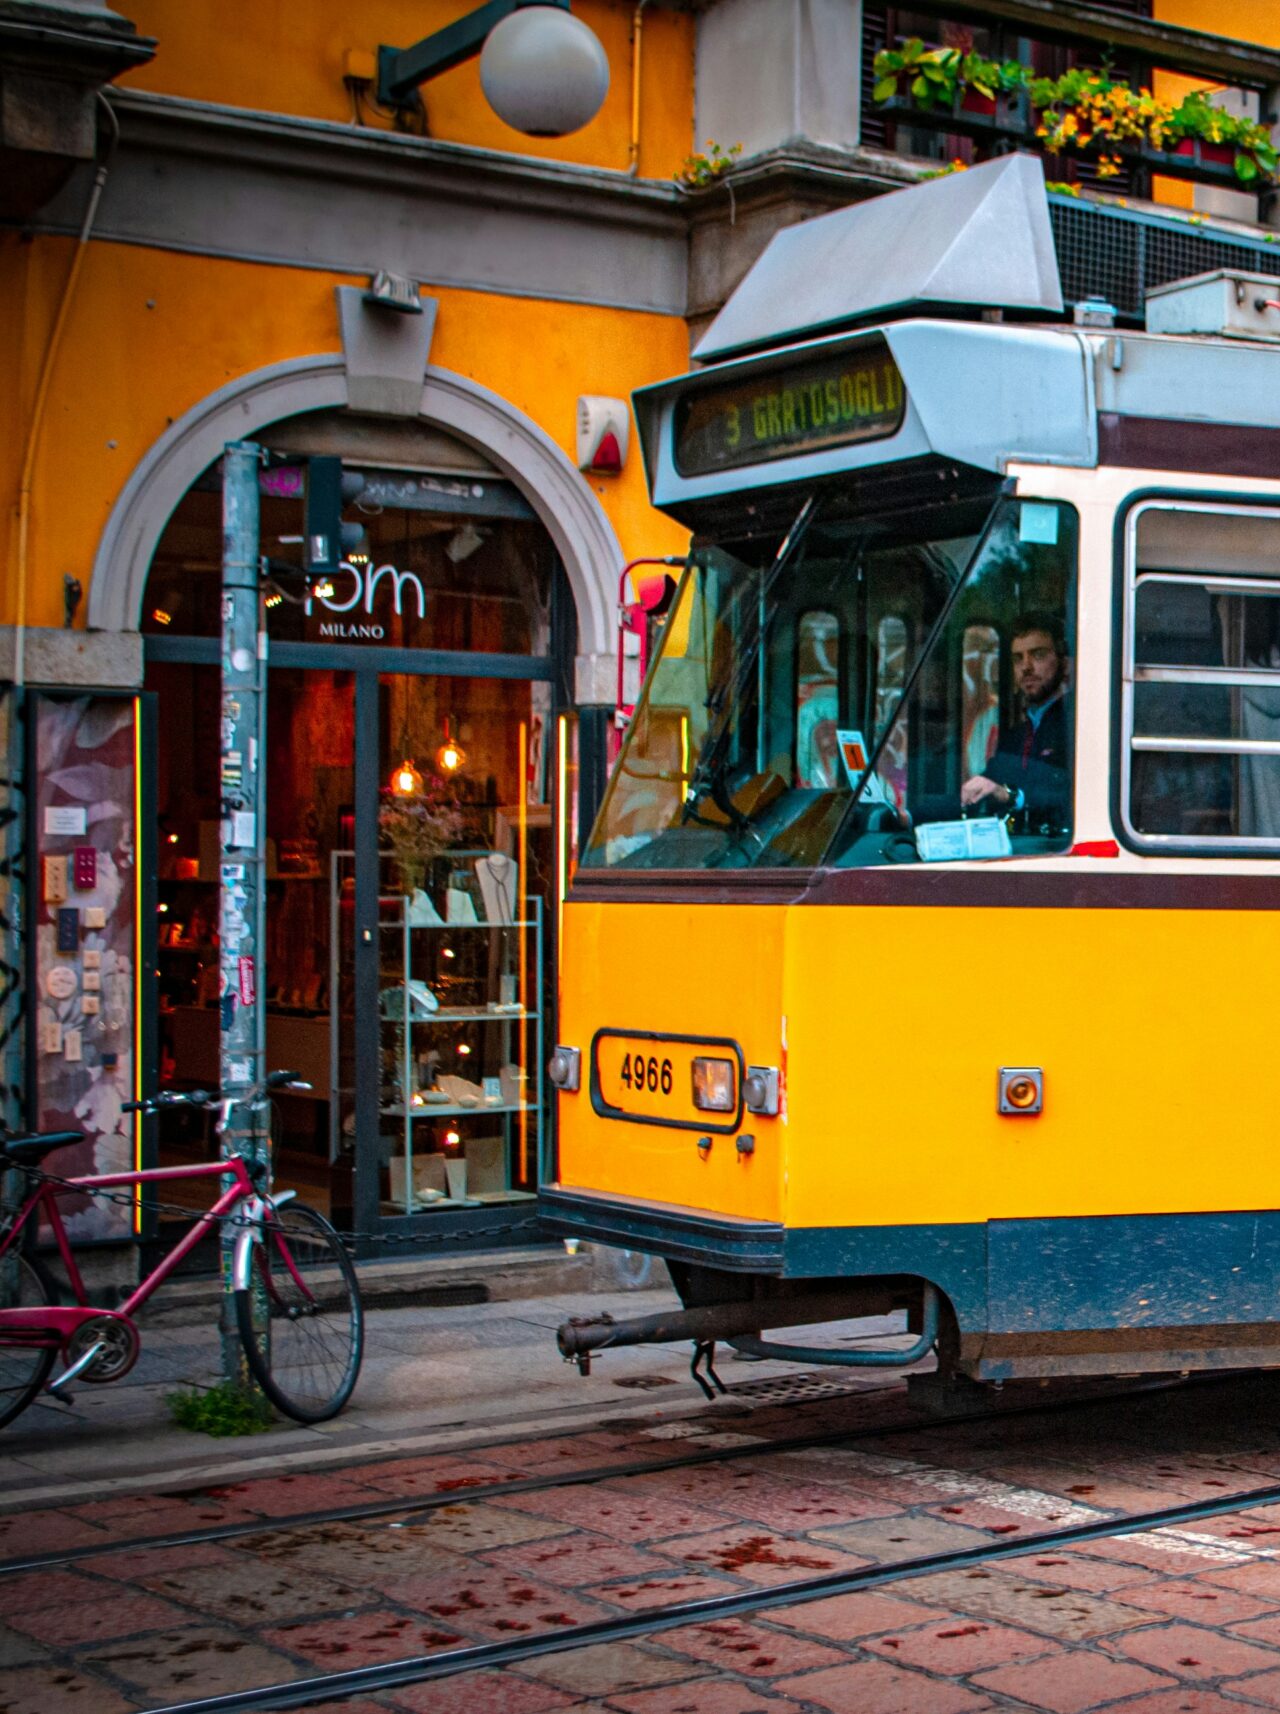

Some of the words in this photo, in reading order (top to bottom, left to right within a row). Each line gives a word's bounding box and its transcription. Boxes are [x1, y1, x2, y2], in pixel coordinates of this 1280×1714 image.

[727, 402, 741, 446] 3
[319, 622, 385, 640] MILANO
[621, 1052, 673, 1096] 4966
